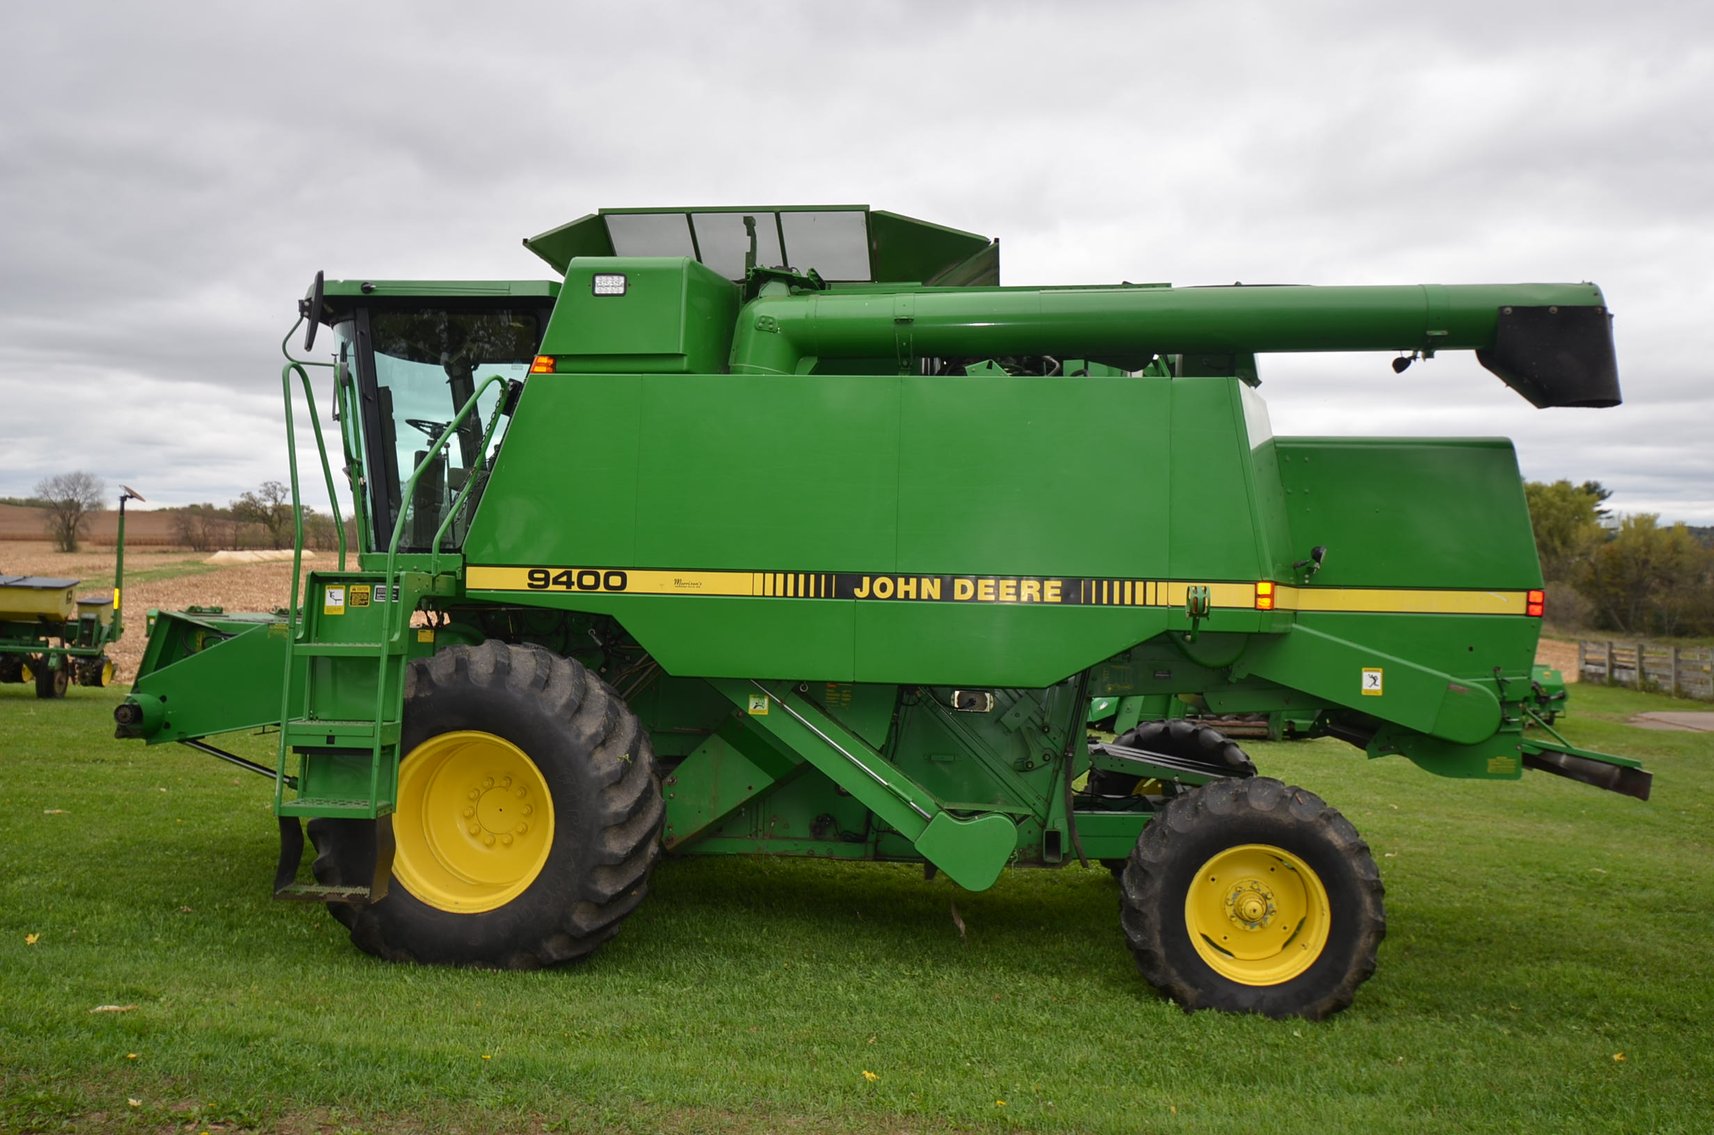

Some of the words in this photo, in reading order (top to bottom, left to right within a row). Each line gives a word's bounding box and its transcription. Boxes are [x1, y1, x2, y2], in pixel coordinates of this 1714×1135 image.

[527, 569, 628, 591] 9400
[853, 576, 941, 600] JOHN
[953, 578, 1063, 602] DEERE
